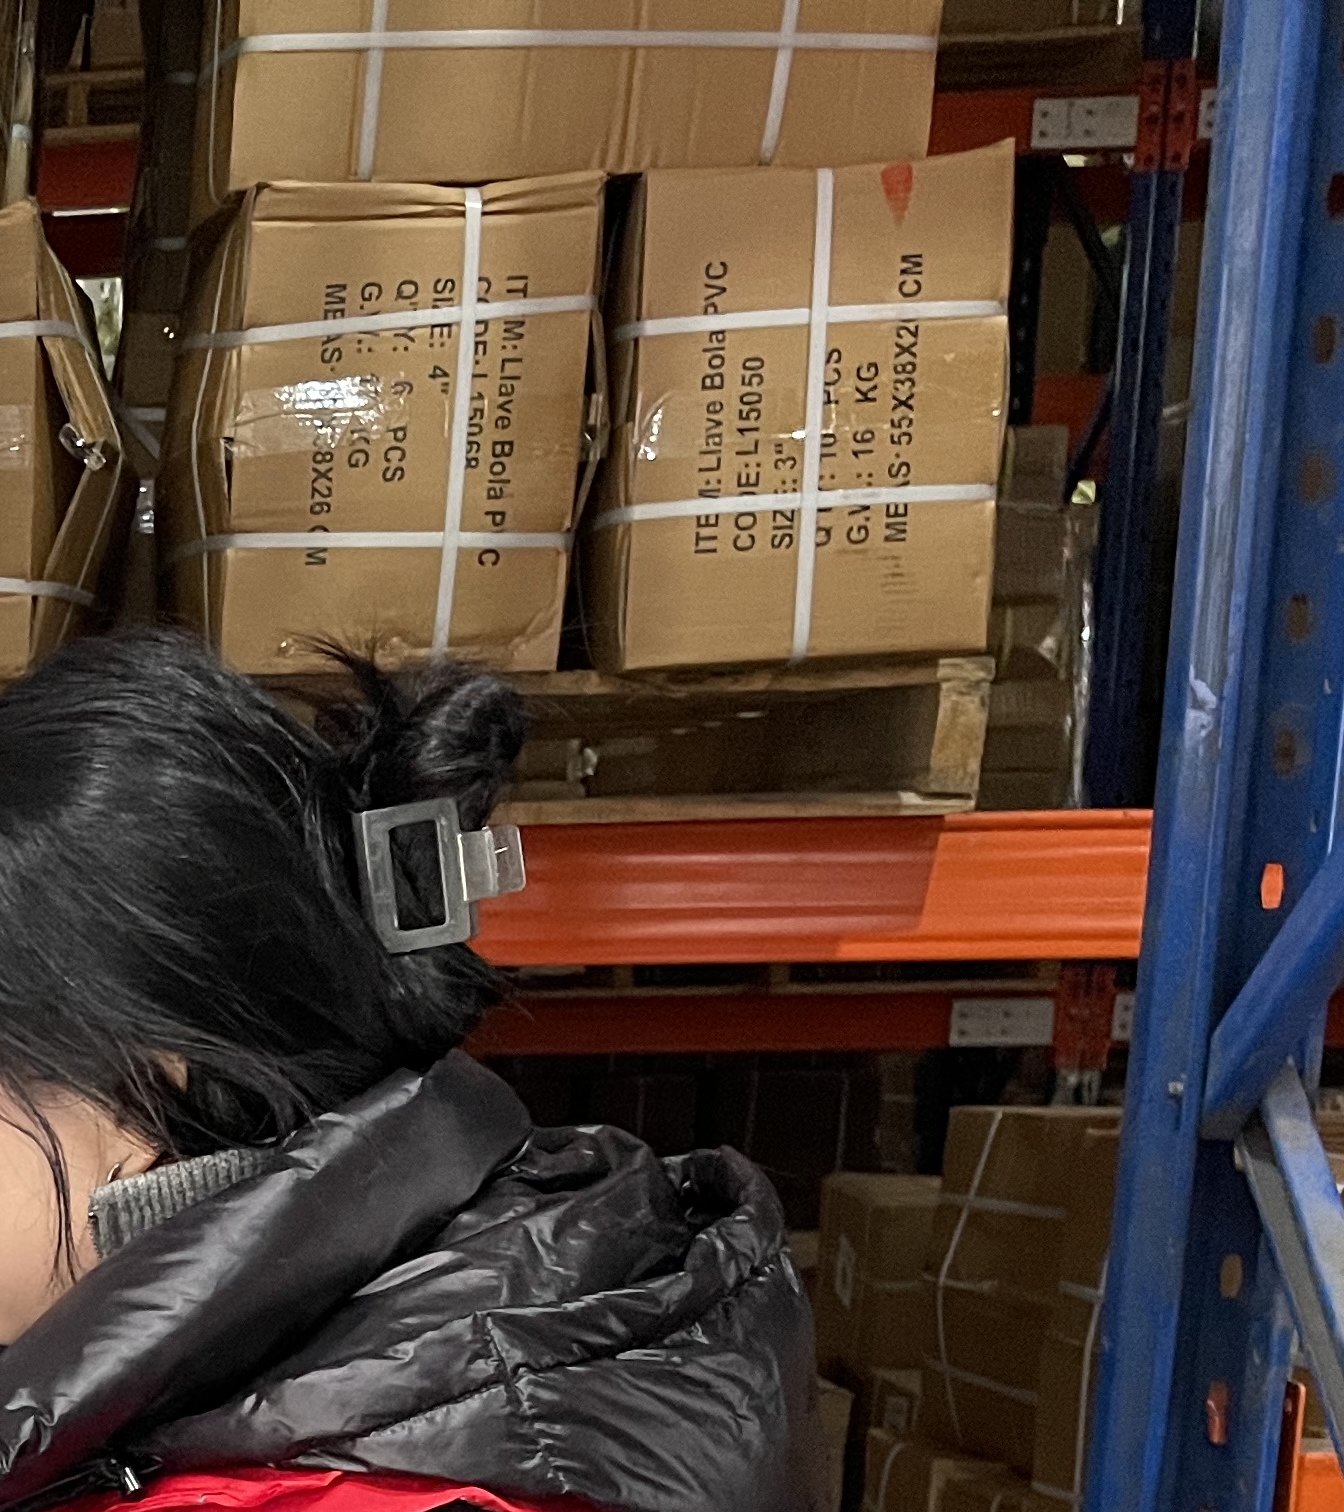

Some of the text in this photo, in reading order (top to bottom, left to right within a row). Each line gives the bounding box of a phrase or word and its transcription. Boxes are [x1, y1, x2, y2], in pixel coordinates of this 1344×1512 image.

[899, 254, 922, 298] CM
[429, 278, 456, 395] SIE: 4"
[701, 330, 725, 390] Bola
[856, 362, 879, 403] KG
[888, 318, 918, 445] 55X38X2
[382, 426, 407, 482] PCS
[478, 275, 528, 567] ITM: Llave Bola PC
[699, 401, 723, 472] Llave
[733, 357, 764, 551] COE: L15050
[853, 430, 874, 459] 16
[772, 479, 797, 549] SIZ:
